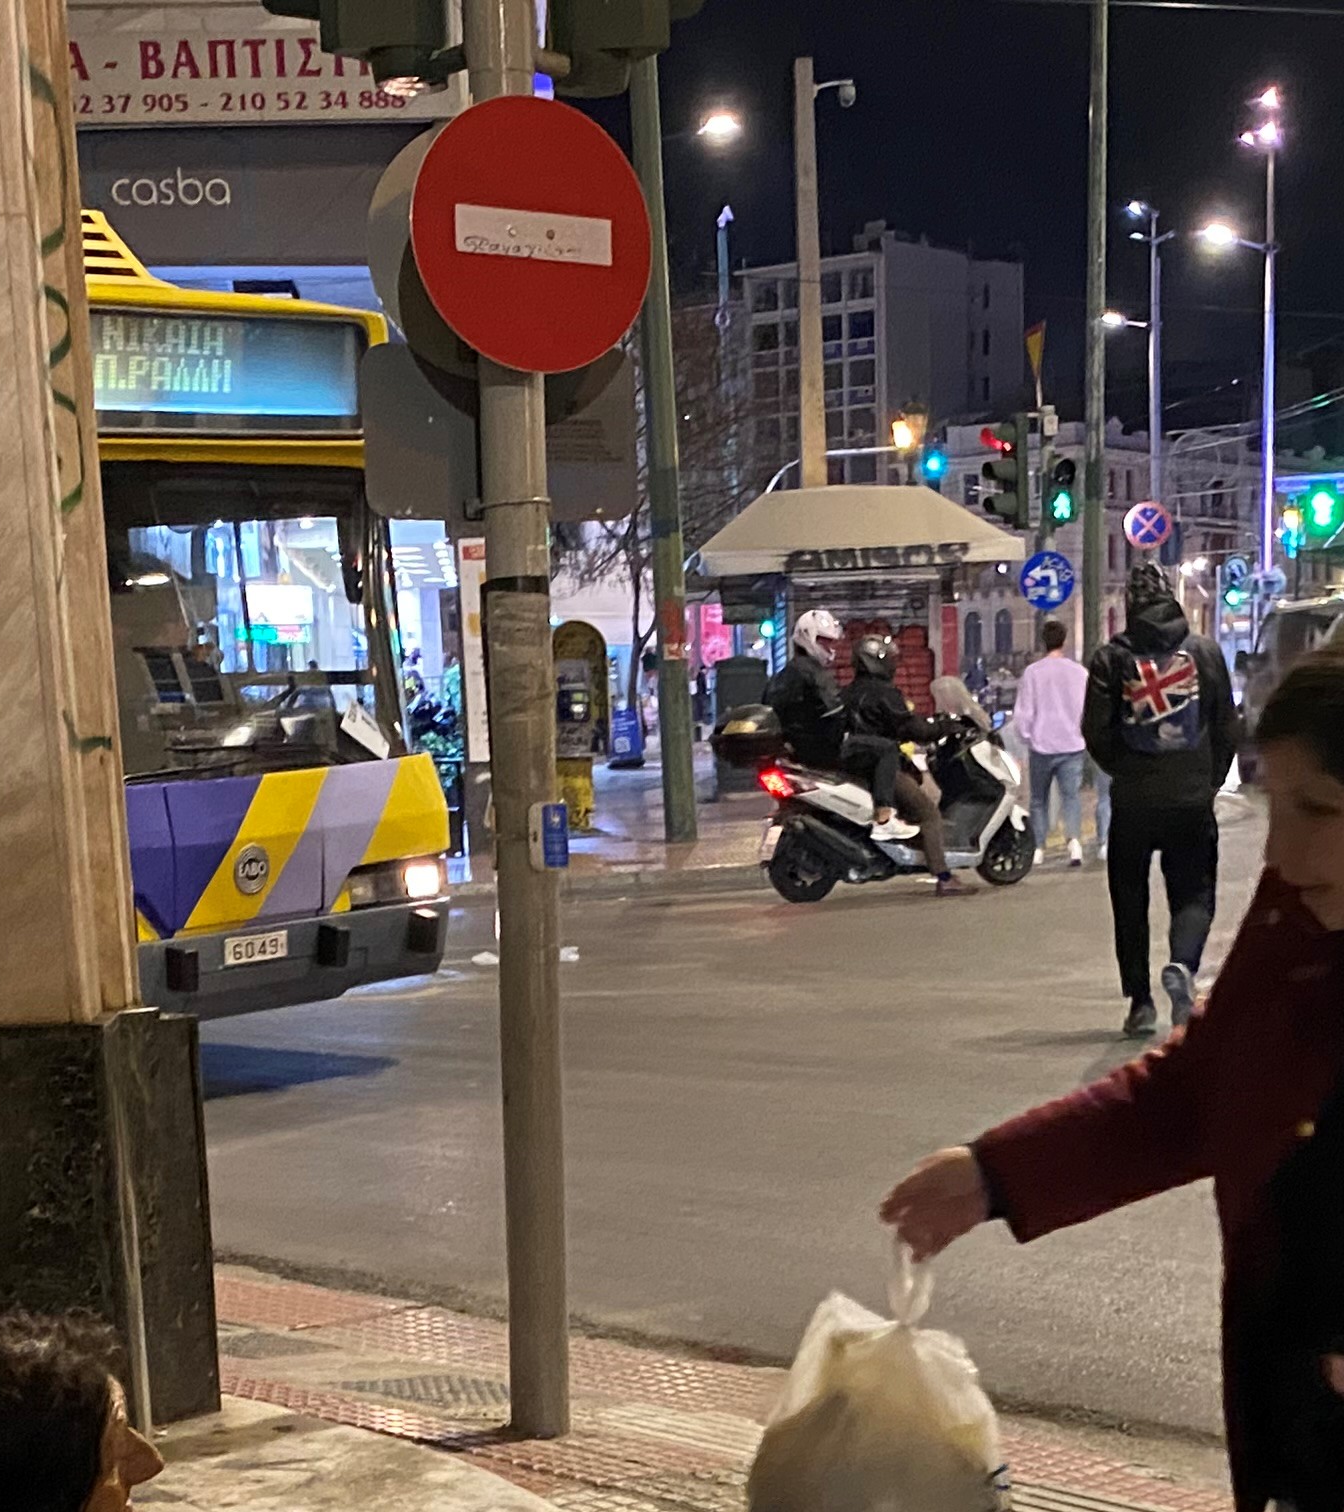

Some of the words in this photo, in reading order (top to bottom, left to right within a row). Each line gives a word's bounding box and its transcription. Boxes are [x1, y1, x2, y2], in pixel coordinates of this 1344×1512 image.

[102, 94, 129, 114] 37
[143, 93, 188, 113] 905
[220, 92, 265, 112] 210
[276, 91, 308, 111] 52
[318, 90, 348, 110] 34
[110, 168, 231, 207] casba
[232, 938, 279, 961] 6049
